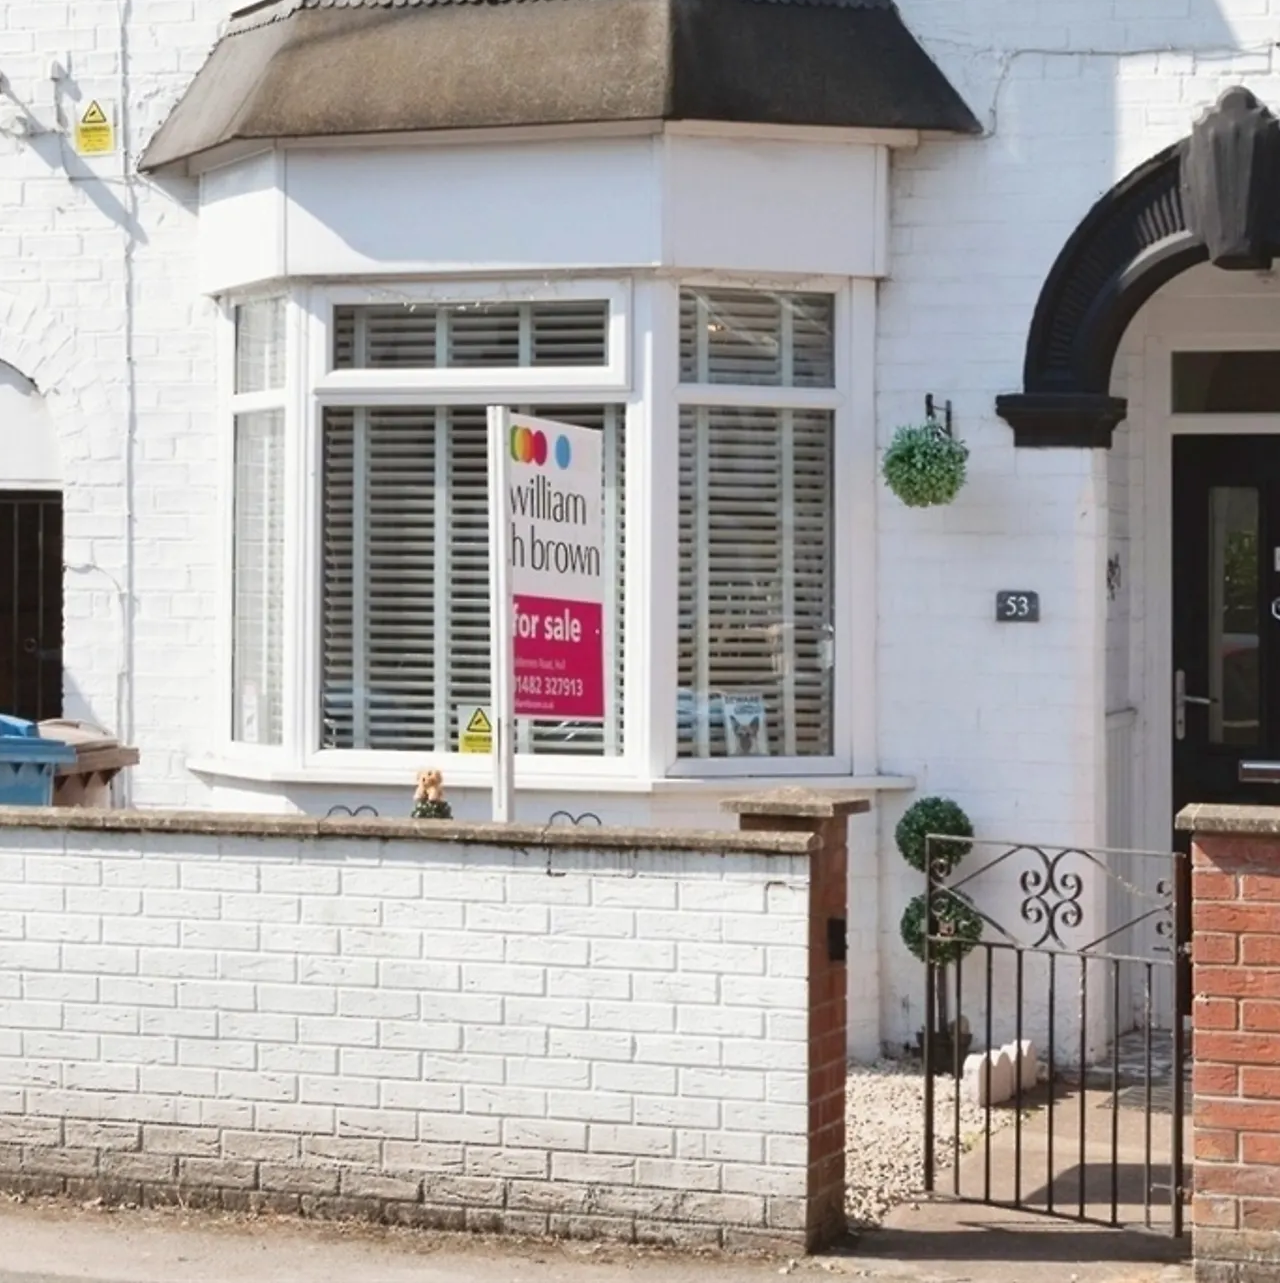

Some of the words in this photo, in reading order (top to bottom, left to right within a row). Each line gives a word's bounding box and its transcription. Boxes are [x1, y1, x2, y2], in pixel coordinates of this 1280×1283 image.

[510, 474, 586, 526] william
[511, 522, 525, 568] h
[531, 524, 600, 577] brown
[512, 603, 540, 639] for
[544, 608, 582, 643] sale
[1005, 596, 1029, 617] 53
[544, 676, 584, 697] 327913
